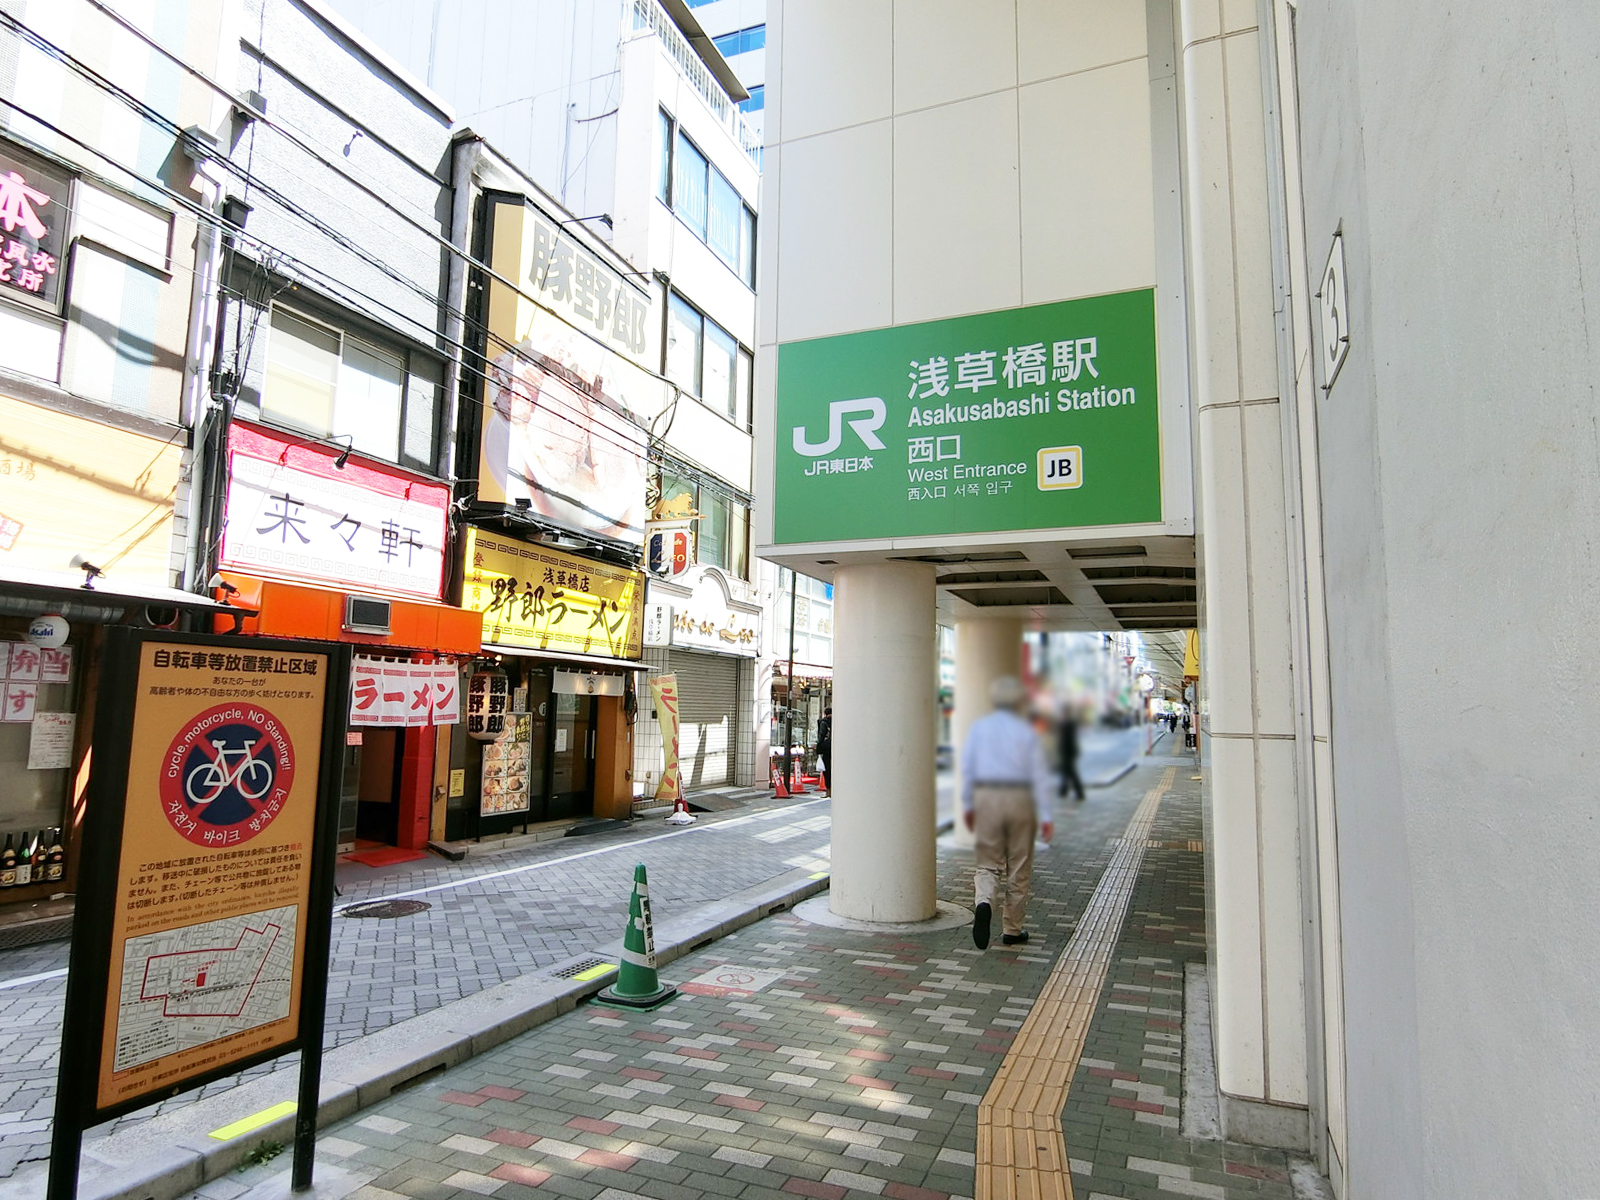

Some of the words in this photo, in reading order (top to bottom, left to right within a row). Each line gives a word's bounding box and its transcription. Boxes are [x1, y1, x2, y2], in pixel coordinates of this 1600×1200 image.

[0, 234, 55, 275] 風水
[528, 219, 647, 355] 豚野郎
[1326, 267, 1340, 362] 3
[907, 336, 1099, 399] 浅草橋駅
[907, 391, 1050, 427] Asakusabashi
[1056, 384, 1136, 412] Station
[792, 396, 887, 457] JR
[907, 434, 961, 464] 西口
[804, 455, 874, 476] JR東日本
[907, 468, 948, 483] West
[953, 461, 1027, 480] Entrance
[1047, 458, 1072, 478] JB
[907, 485, 947, 501] 西入口
[953, 482, 980, 498] 서쪽
[985, 480, 1013, 496] 입구
[256, 493, 424, 568] 来々軒
[543, 566, 591, 592] 浅草橋店
[490, 577, 626, 634] 野郎ラーメン
[153, 649, 318, 676] 自転車等放置禁止区域
[212, 676, 267, 687] あなたの一台が
[354, 677, 454, 710] ラーメン
[8, 689, 34, 714] す
[167, 744, 189, 778] cycle,
[185, 708, 244, 743] motorcycle,
[247, 709, 265, 725] NO
[264, 720, 291, 771] Standing!!
[203, 829, 241, 845] 바이크
